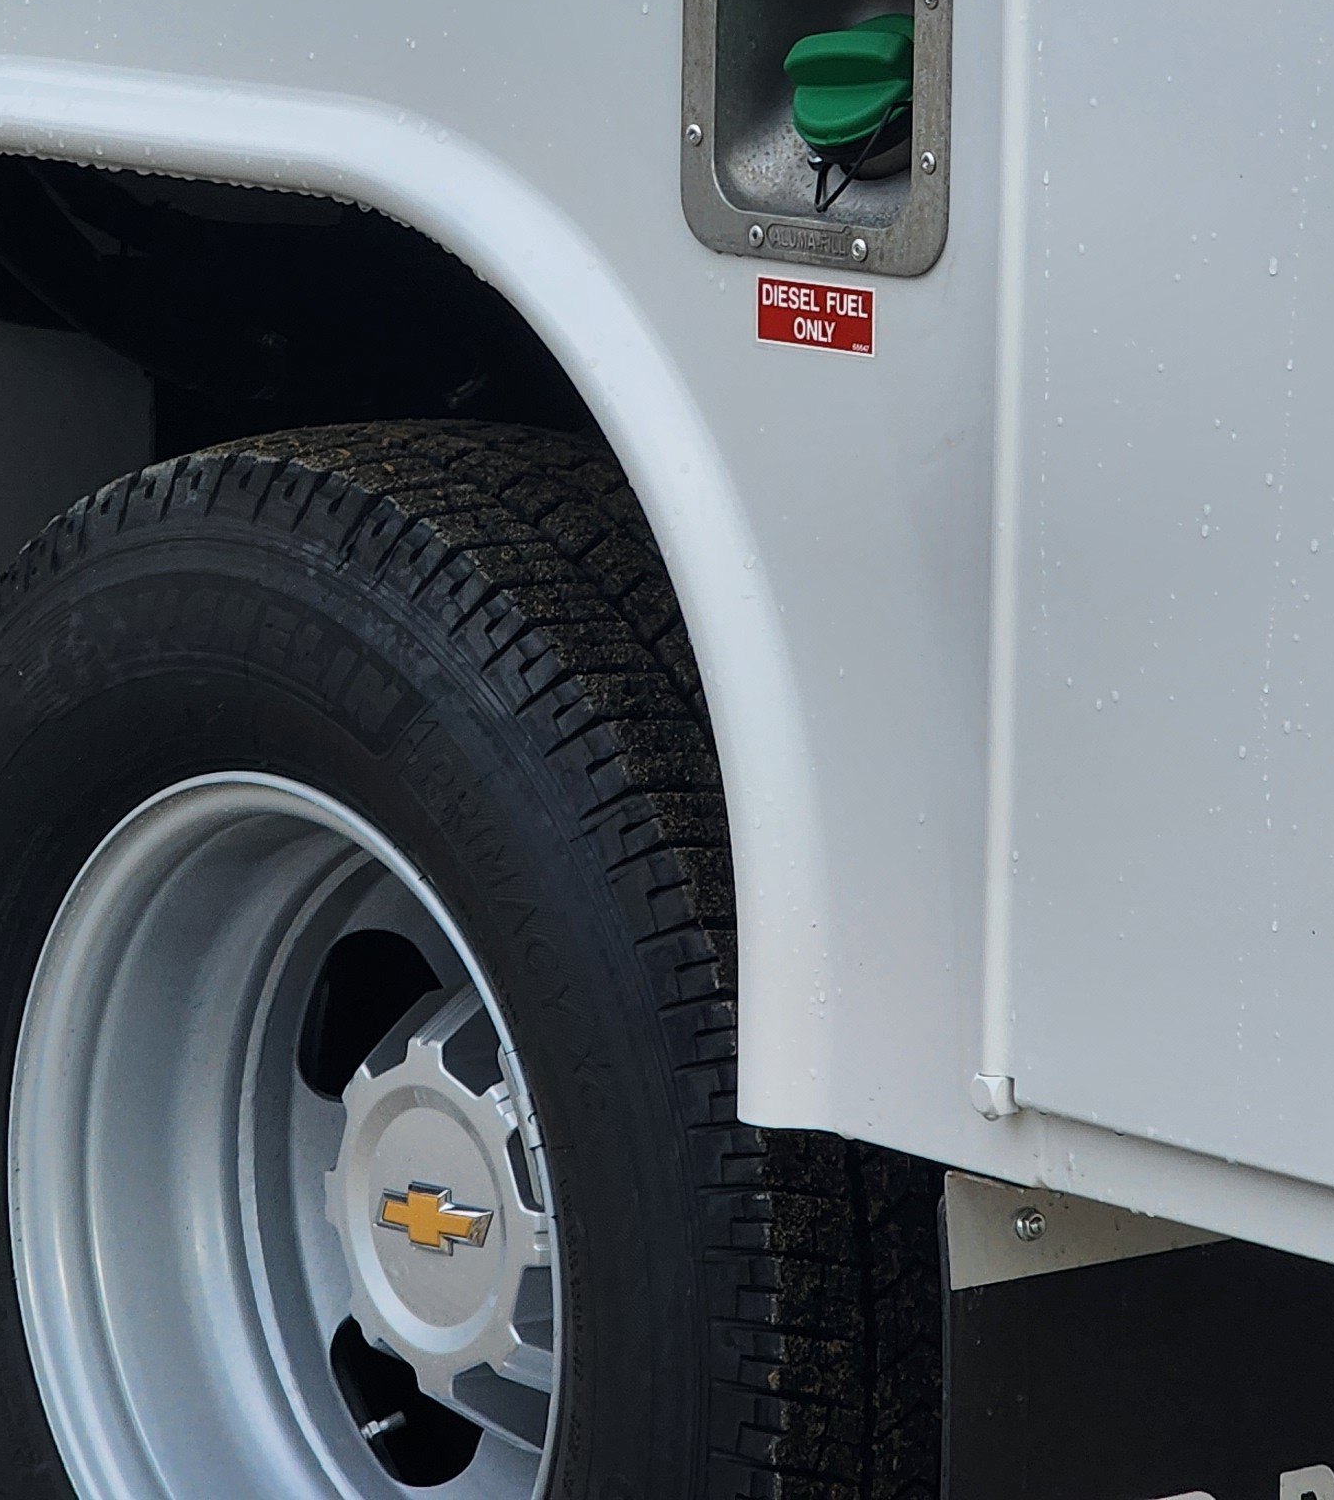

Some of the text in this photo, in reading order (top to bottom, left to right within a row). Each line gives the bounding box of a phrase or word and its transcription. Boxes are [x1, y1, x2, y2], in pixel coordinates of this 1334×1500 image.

[762, 283, 868, 318] DIESEL FUEL
[793, 316, 836, 342] ONLY
